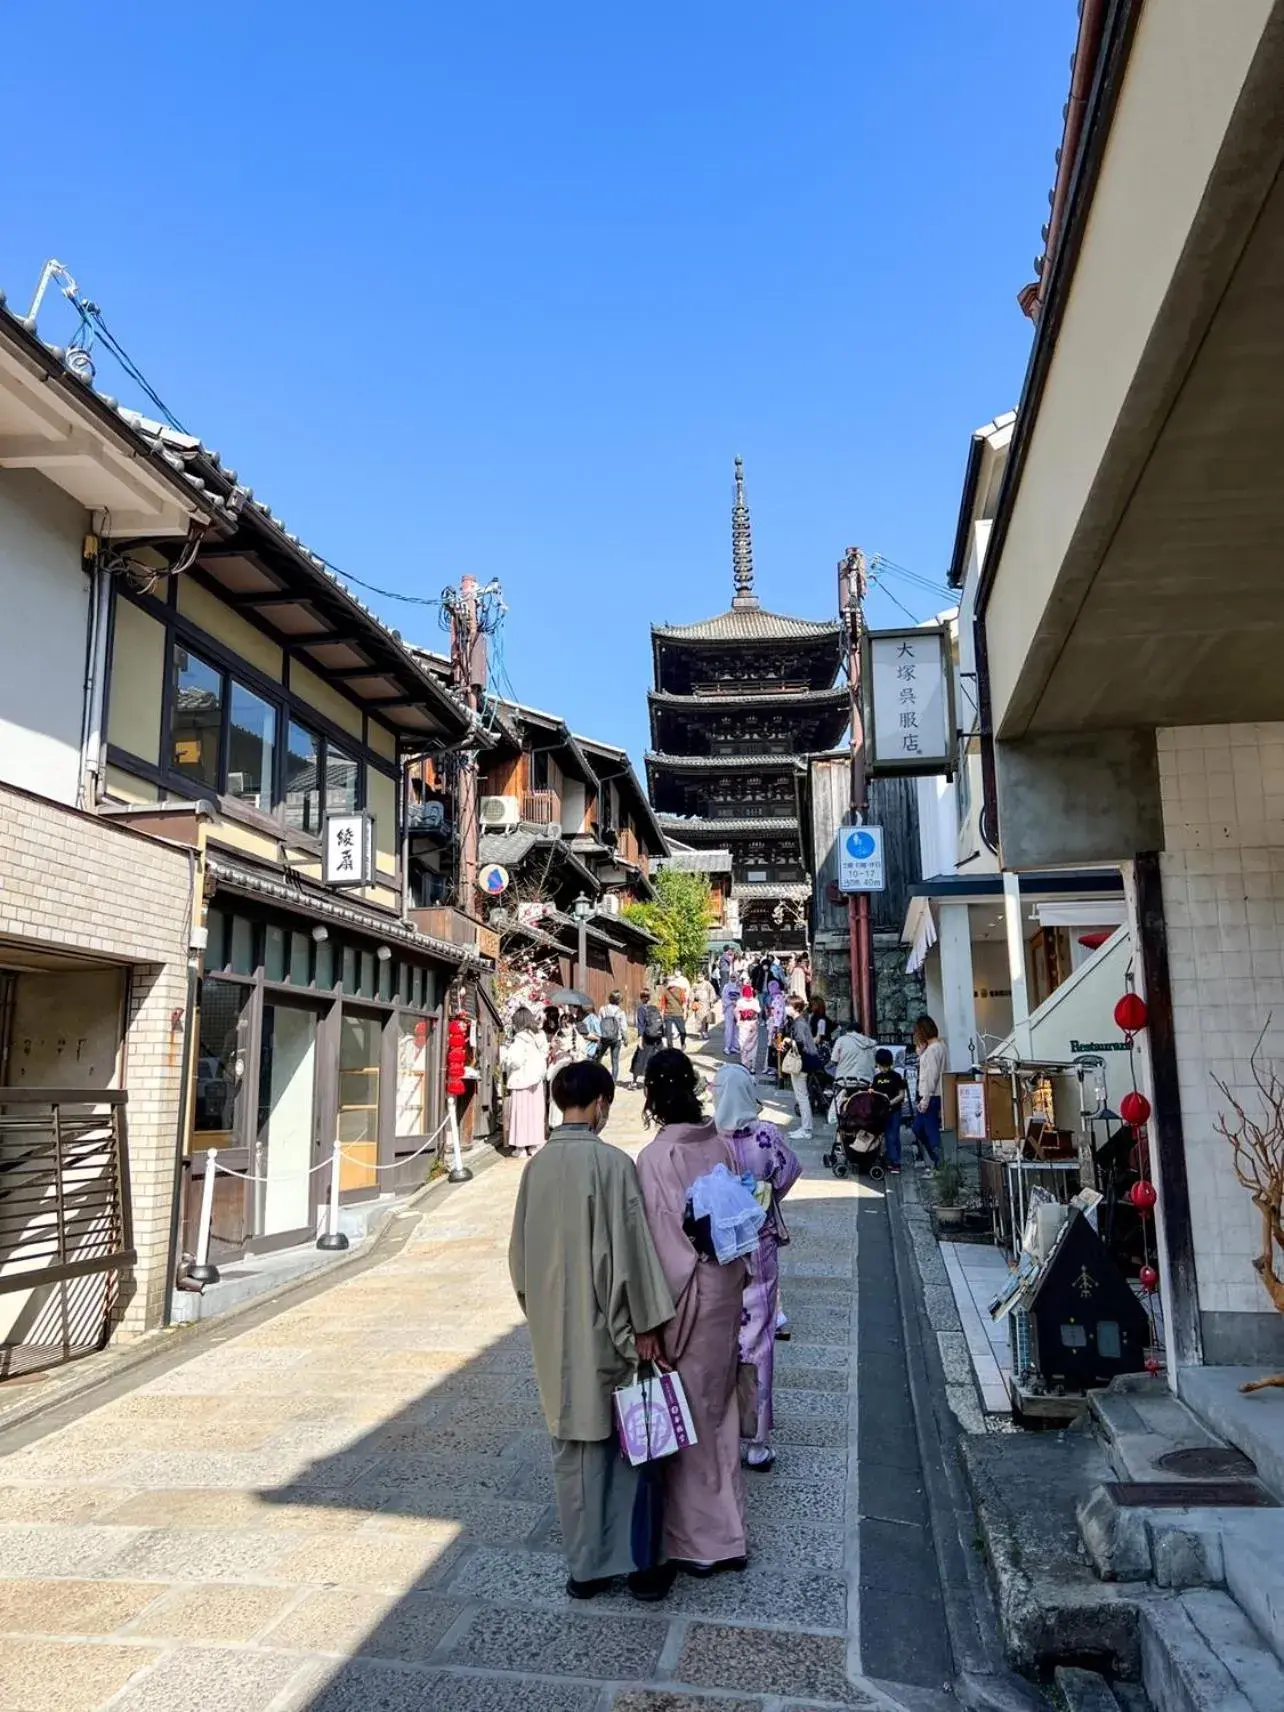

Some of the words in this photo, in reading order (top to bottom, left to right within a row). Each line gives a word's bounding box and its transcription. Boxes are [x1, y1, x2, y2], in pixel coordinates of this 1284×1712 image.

[896, 641, 919, 752] 大塚呉服店
